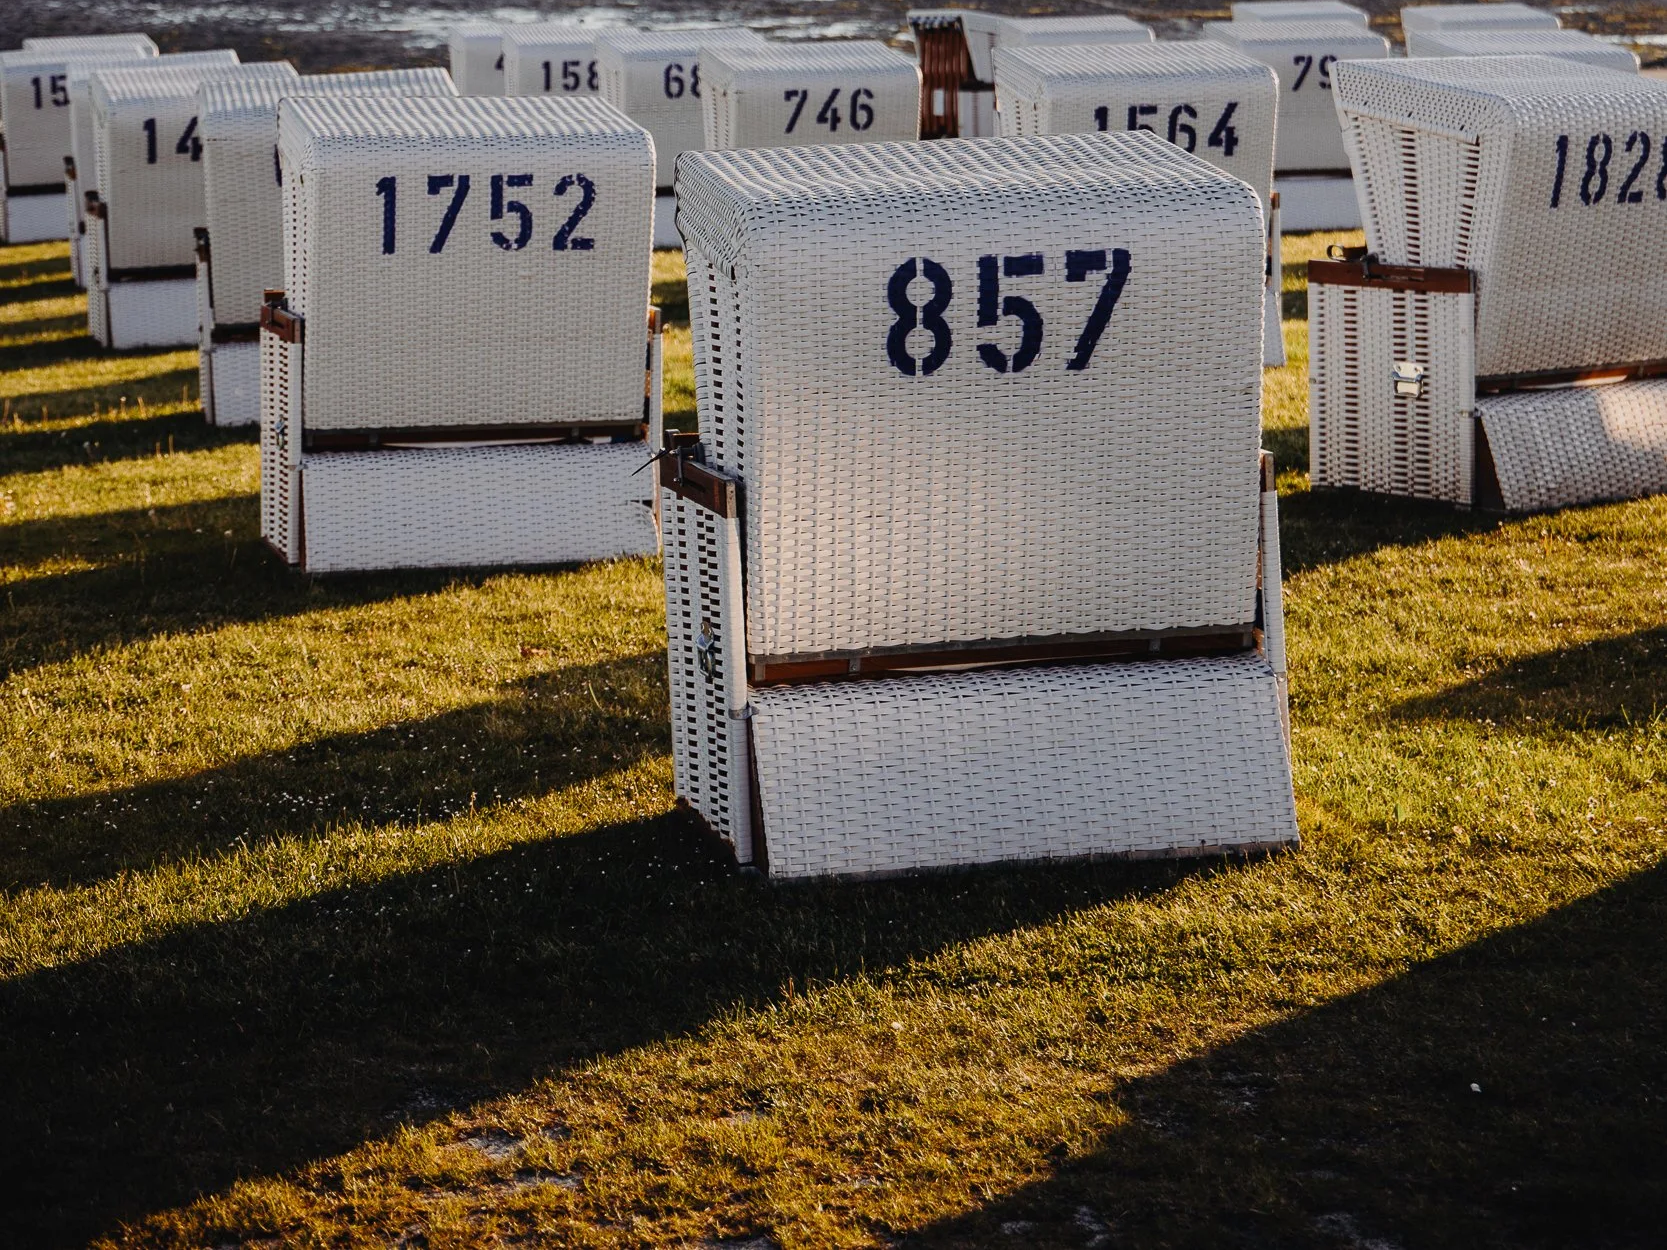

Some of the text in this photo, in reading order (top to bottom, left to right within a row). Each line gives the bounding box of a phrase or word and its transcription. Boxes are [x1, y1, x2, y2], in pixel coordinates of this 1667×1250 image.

[142, 116, 203, 164] 14
[784, 88, 875, 134] 746
[375, 172, 597, 256] 1752
[886, 248, 1132, 377] 857
